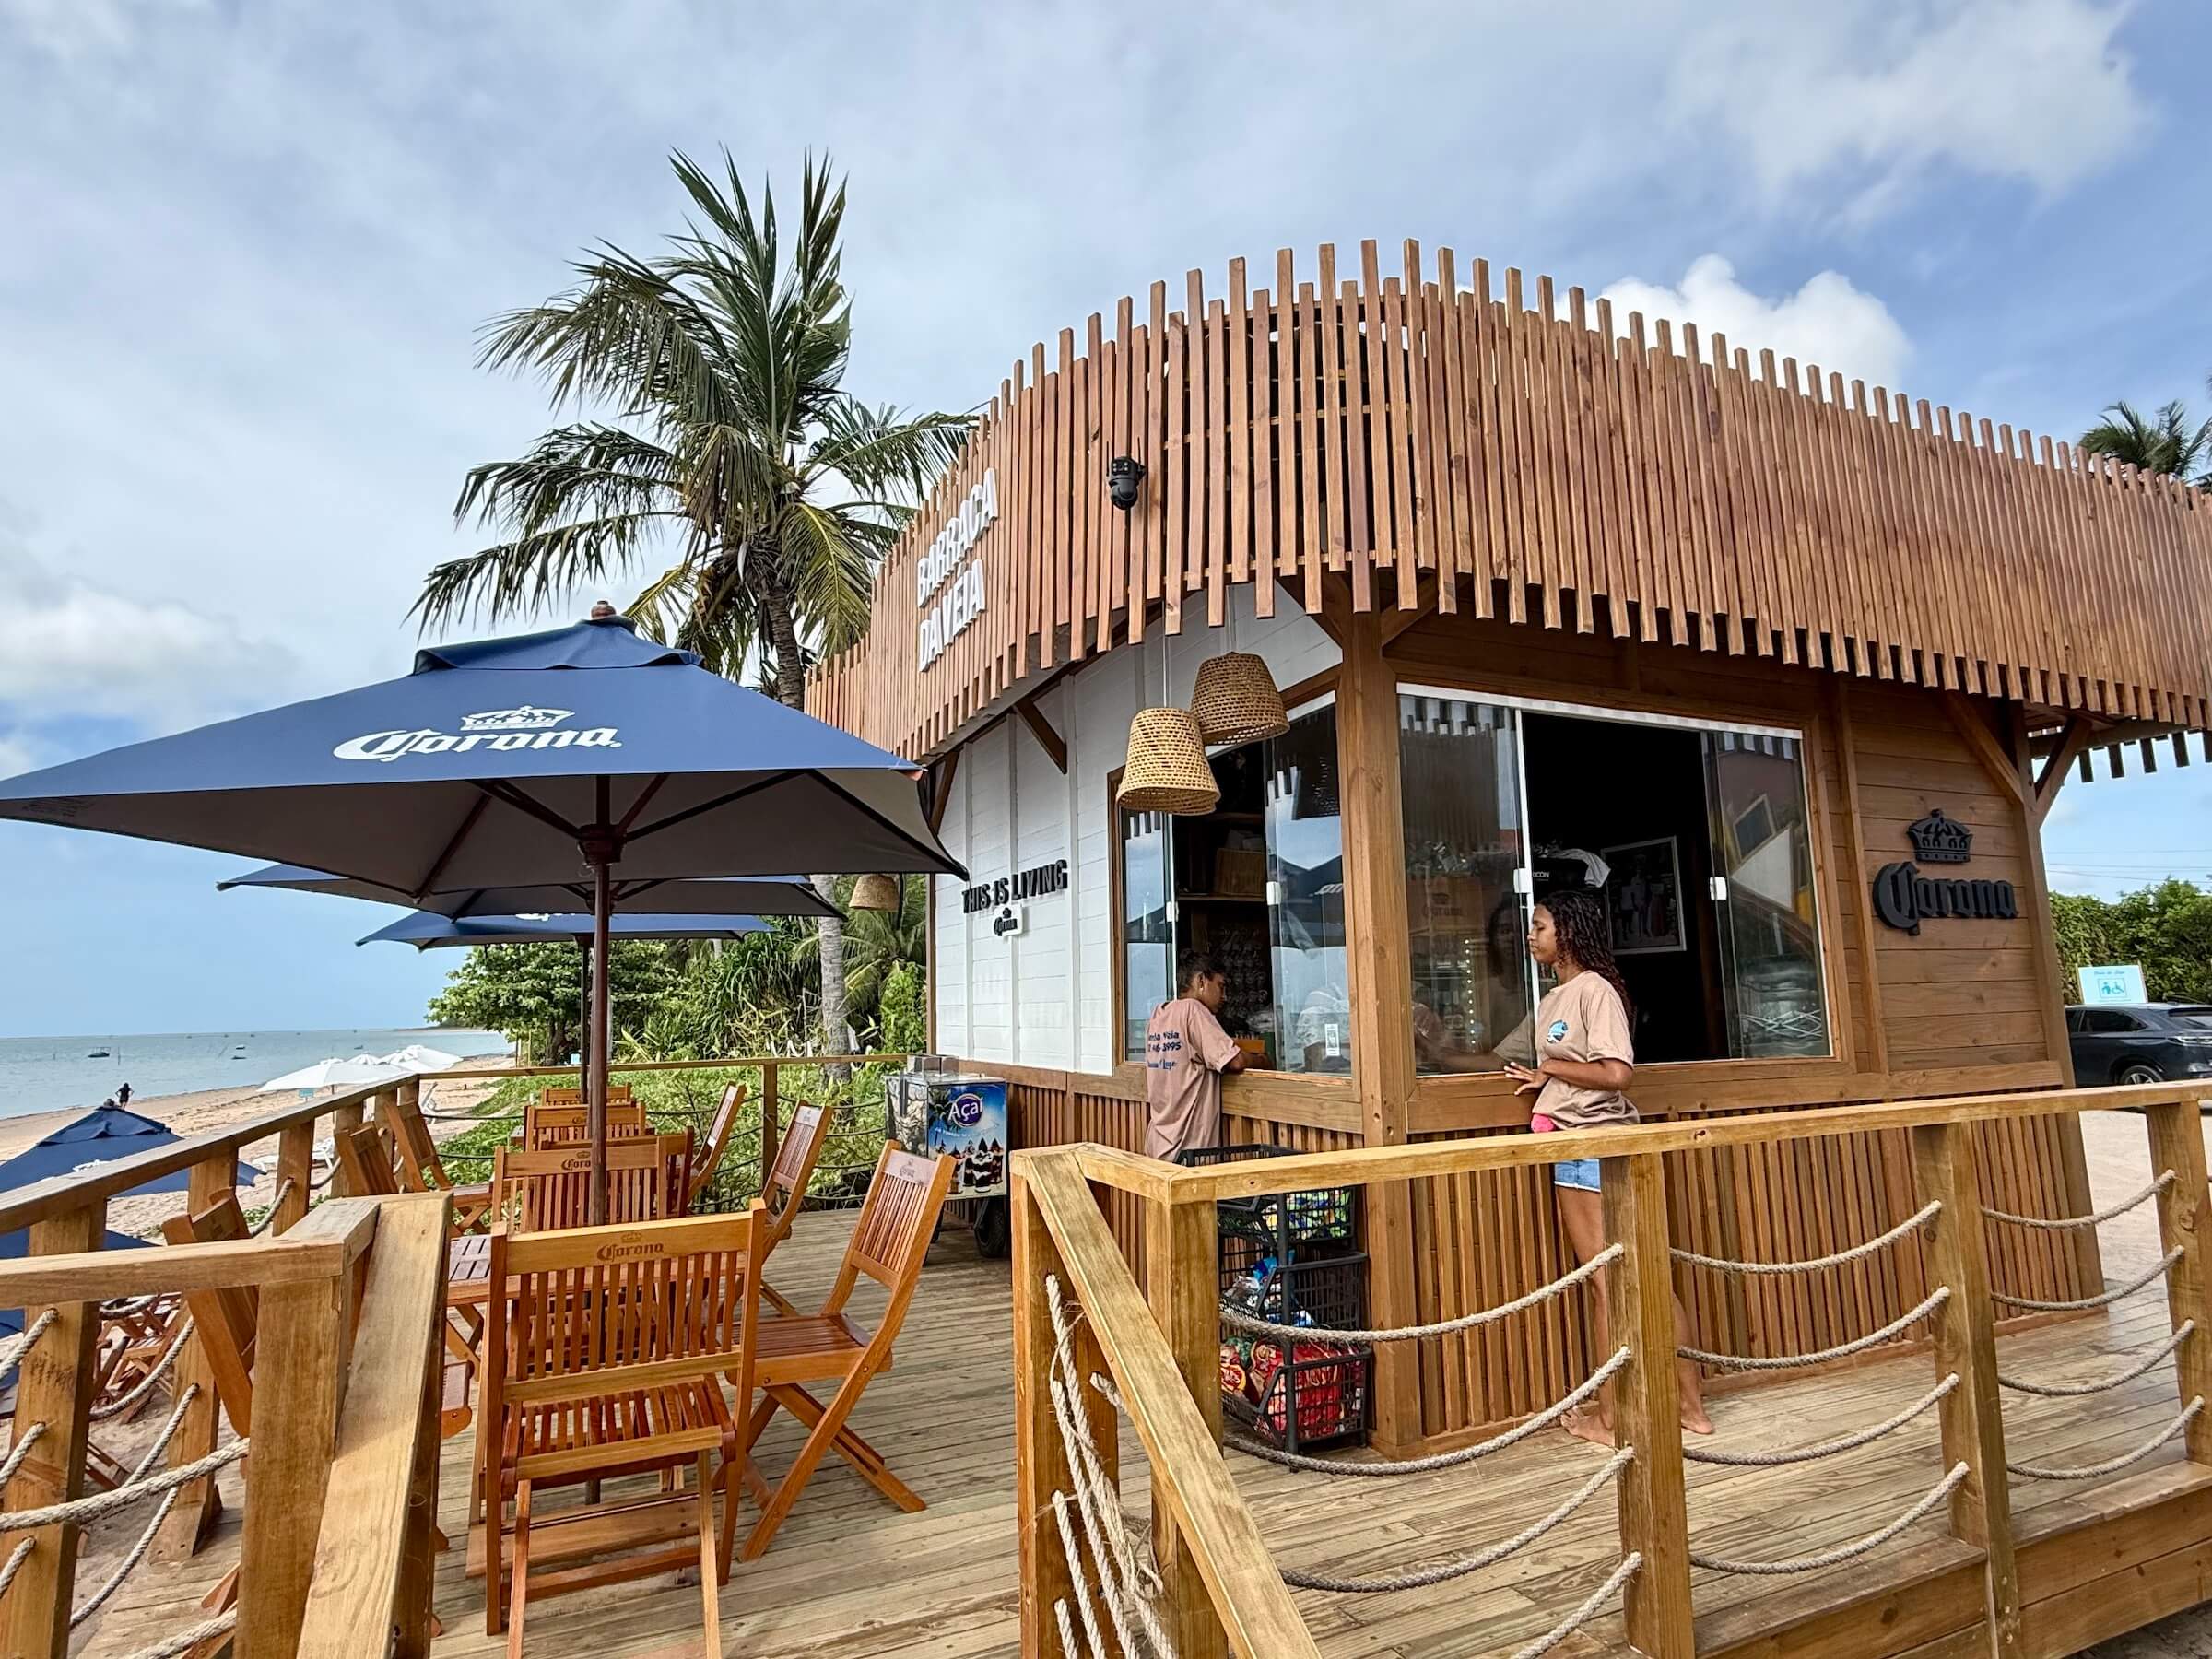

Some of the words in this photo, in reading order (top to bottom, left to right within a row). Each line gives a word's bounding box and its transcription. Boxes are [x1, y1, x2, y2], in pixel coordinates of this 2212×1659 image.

[917, 466, 998, 609] BARRACA
[919, 606, 944, 673] DA
[961, 883, 991, 914] THIS
[993, 877, 1009, 906] IS
[1011, 859, 1068, 901] LIVING
[1873, 861, 2018, 935] Corona
[947, 1097, 983, 1122] Açaí
[597, 1243, 665, 1262] Corona
